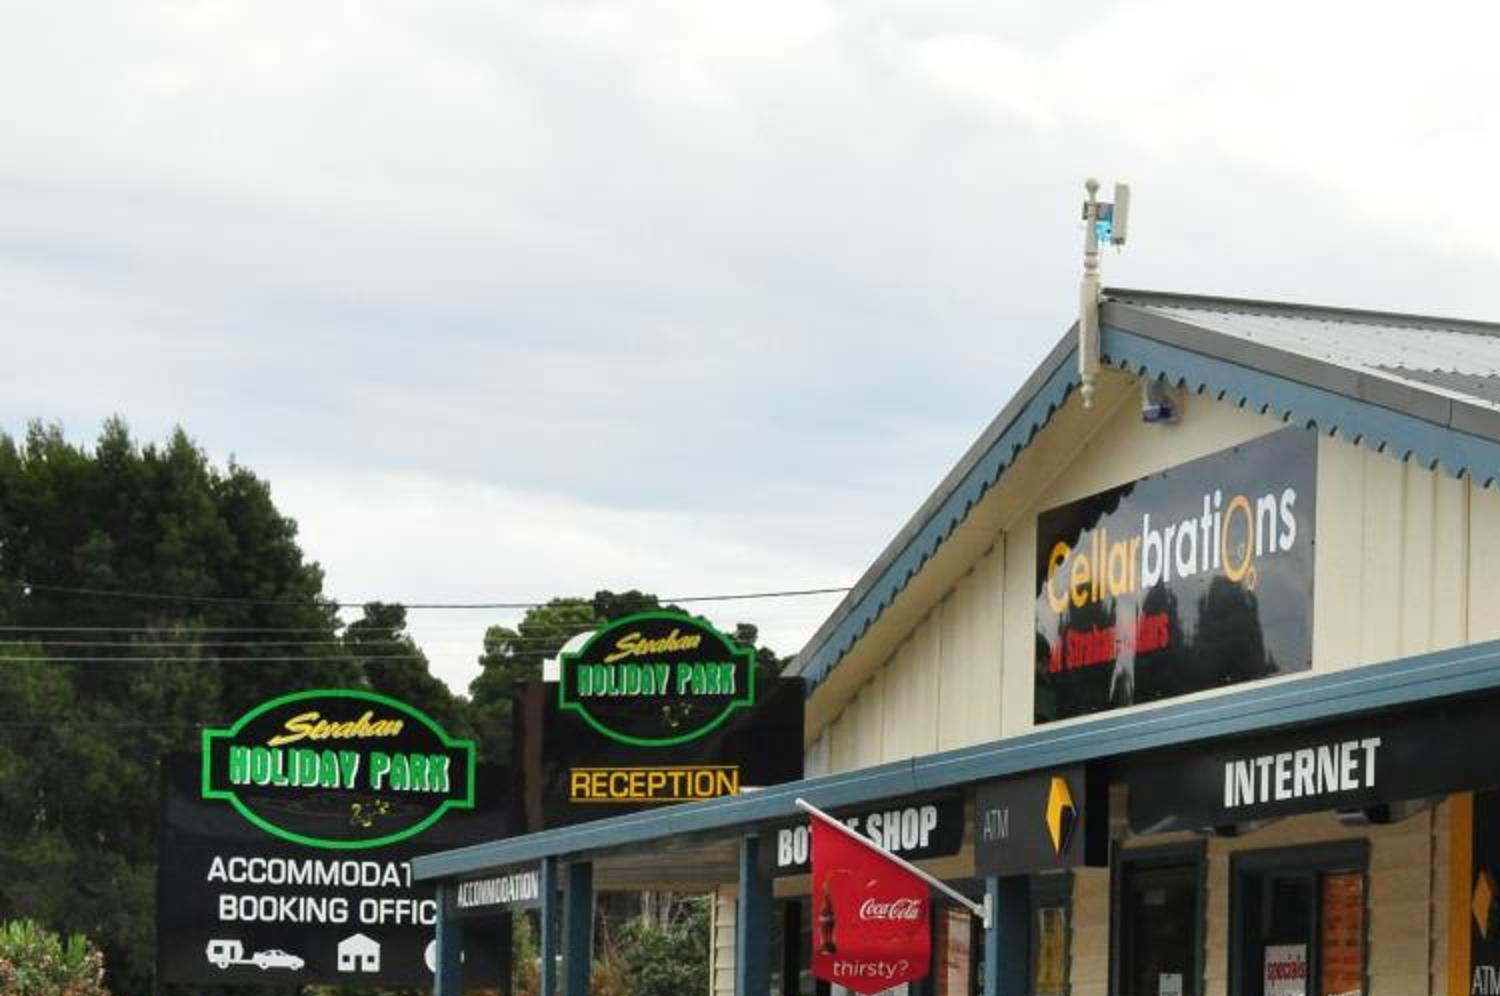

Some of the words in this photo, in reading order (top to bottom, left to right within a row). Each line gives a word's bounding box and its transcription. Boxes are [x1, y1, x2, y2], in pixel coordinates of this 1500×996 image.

[604, 628, 702, 663] Strahan
[577, 664, 671, 696] HOLIDAY
[677, 663, 736, 695] PARK
[267, 710, 404, 746] Strahan
[228, 745, 360, 789] HOLIDAY
[369, 752, 450, 792] PARK
[570, 769, 740, 798] RECEPTION
[1223, 736, 1382, 808] INTERNET
[866, 805, 938, 851] SHOP
[984, 807, 1009, 841] ATM
[207, 856, 411, 888] ACCOMMODAT
[457, 871, 539, 908] ACCOMMODATION
[219, 894, 348, 923] BOOKING
[359, 898, 438, 925] OFFIC
[832, 959, 910, 980] thirsty?
